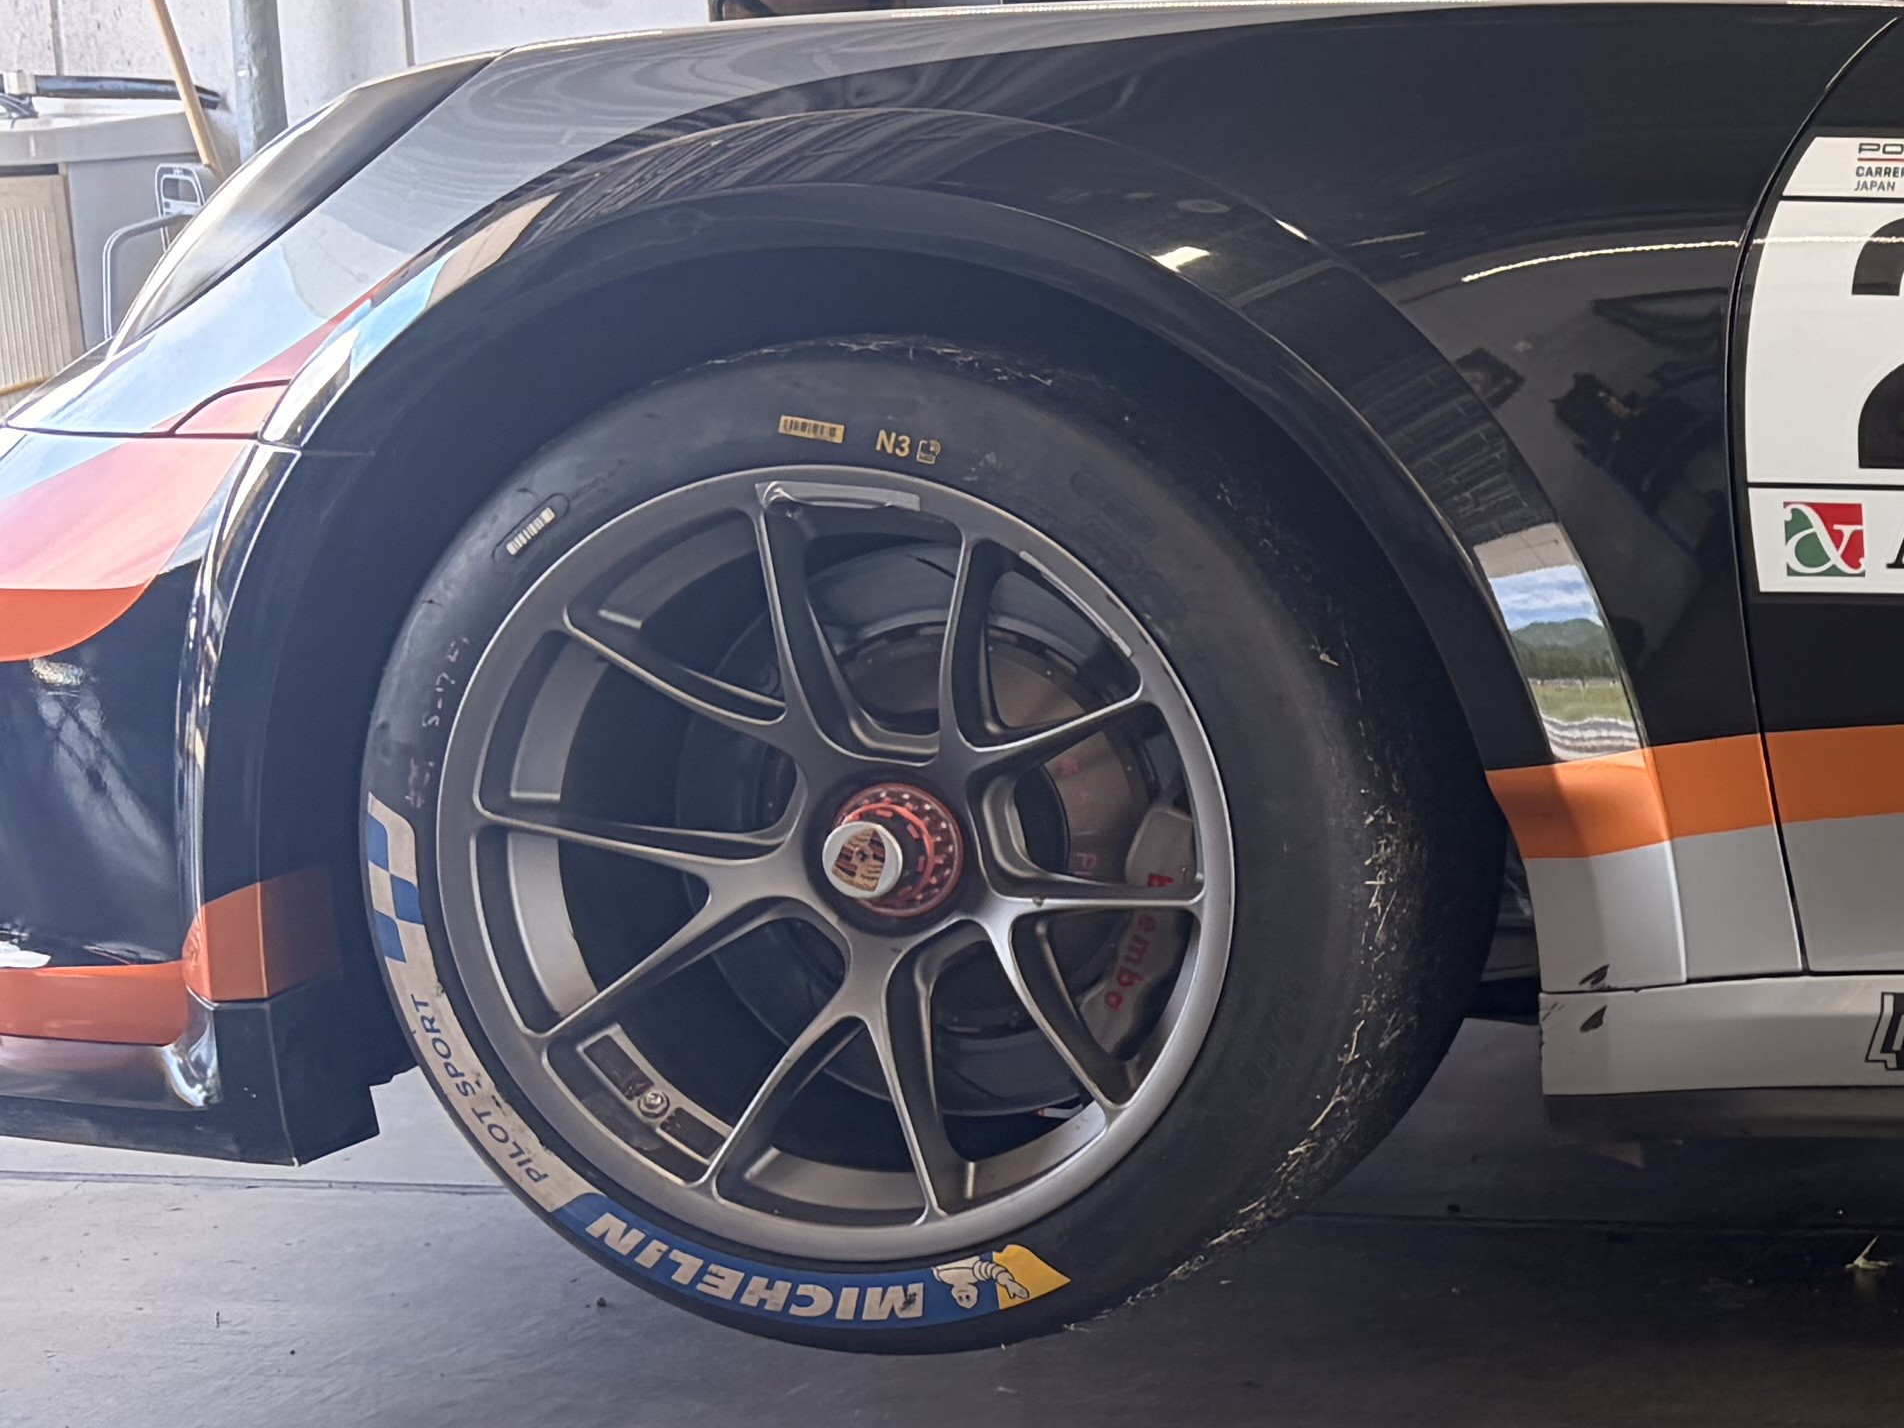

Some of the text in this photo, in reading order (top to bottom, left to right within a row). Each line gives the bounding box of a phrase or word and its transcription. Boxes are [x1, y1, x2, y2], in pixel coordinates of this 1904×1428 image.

[1854, 180, 1896, 192] JAPAN
[875, 429, 910, 458] N3
[1103, 873, 1176, 1011] bembo
[411, 994, 549, 1183] PILOT SPORT
[585, 1212, 924, 1320] MICHELIN
